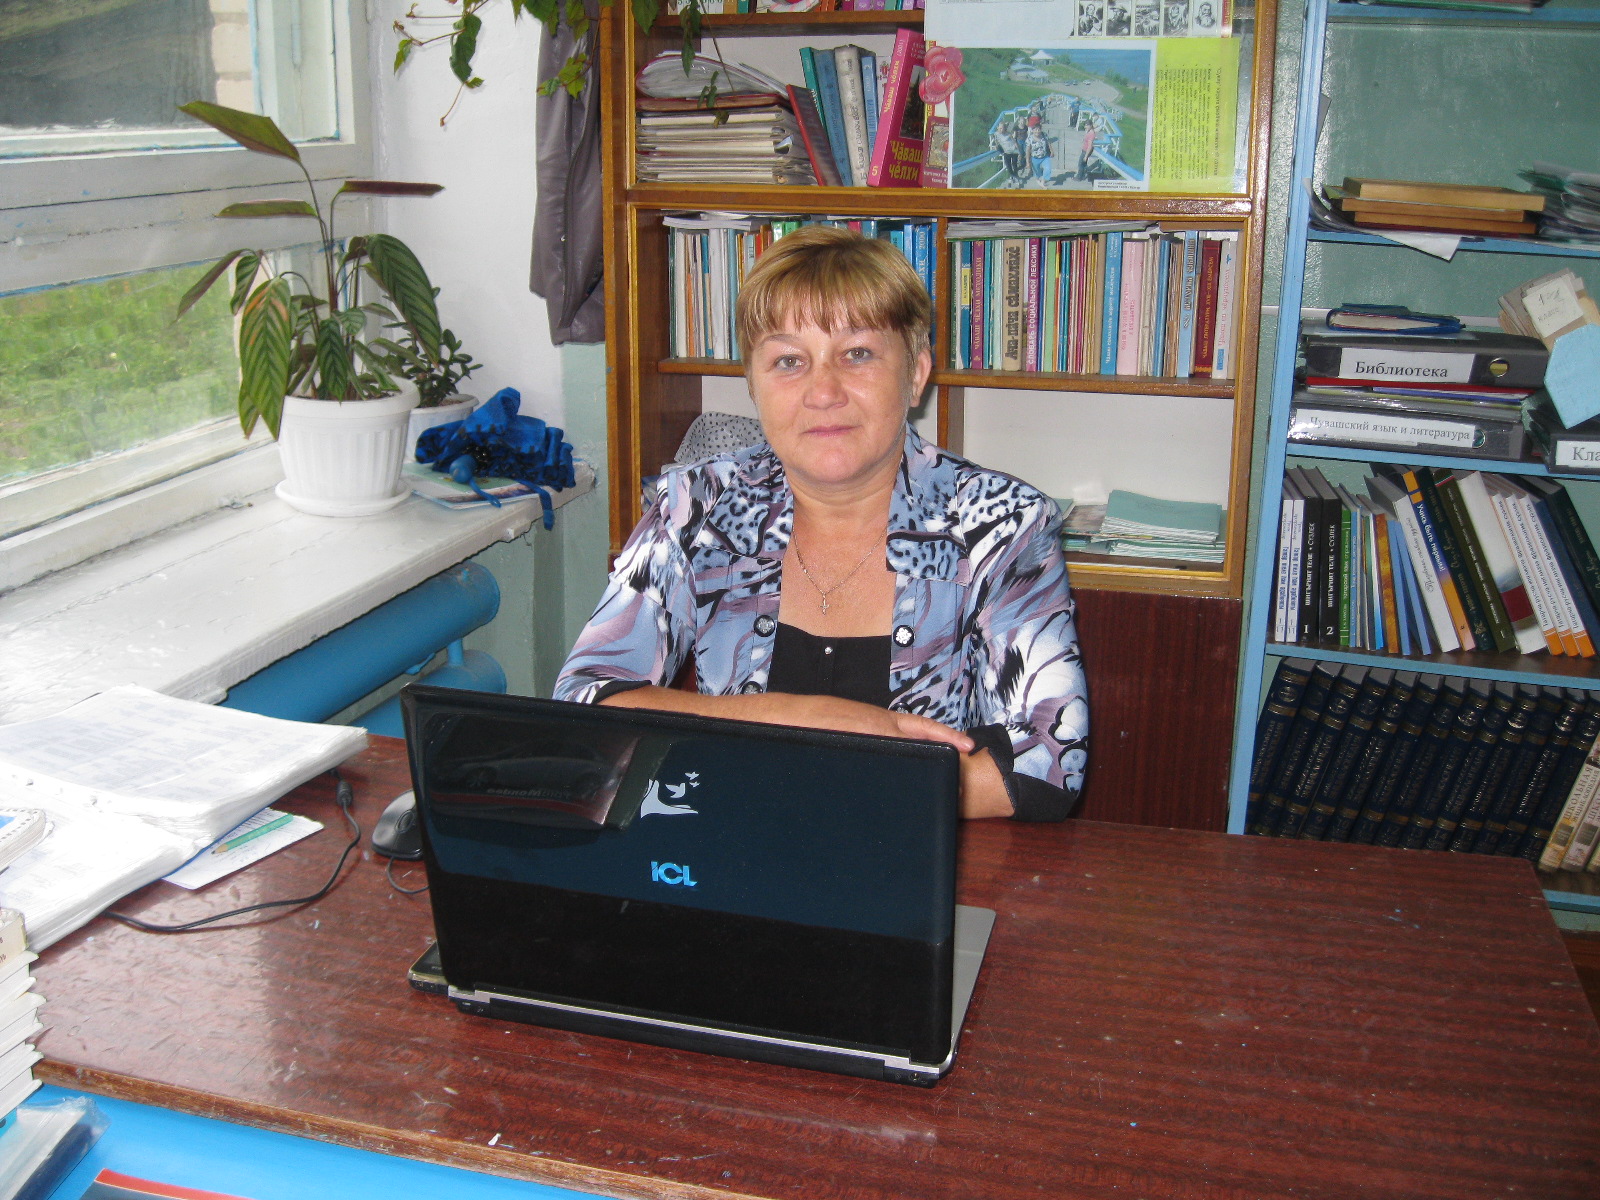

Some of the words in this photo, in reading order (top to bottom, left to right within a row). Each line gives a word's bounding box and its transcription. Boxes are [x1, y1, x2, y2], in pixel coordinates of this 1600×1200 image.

[871, 165, 879, 177] 5
[918, 231, 926, 250] 2000
[975, 257, 983, 297] МЕТОДИКИ
[1029, 279, 1037, 329] СОЦИАЛЬНОЙ
[1004, 311, 1019, 360] Ача-пӑча
[1028, 330, 1036, 365] СЛОВАРЬ
[1355, 360, 1448, 377] Библиотека
[1309, 416, 1370, 431] Чувашский
[1372, 423, 1398, 434] язык
[1410, 427, 1470, 441] литература
[1416, 503, 1427, 526] Учись
[1424, 523, 1434, 543] быть
[1430, 541, 1445, 572] первым!
[1303, 624, 1309, 634] 1
[1326, 626, 1334, 635] 2
[1562, 766, 1592, 820] ШКОЛЬНАЯ
[651, 861, 698, 887] ICL
